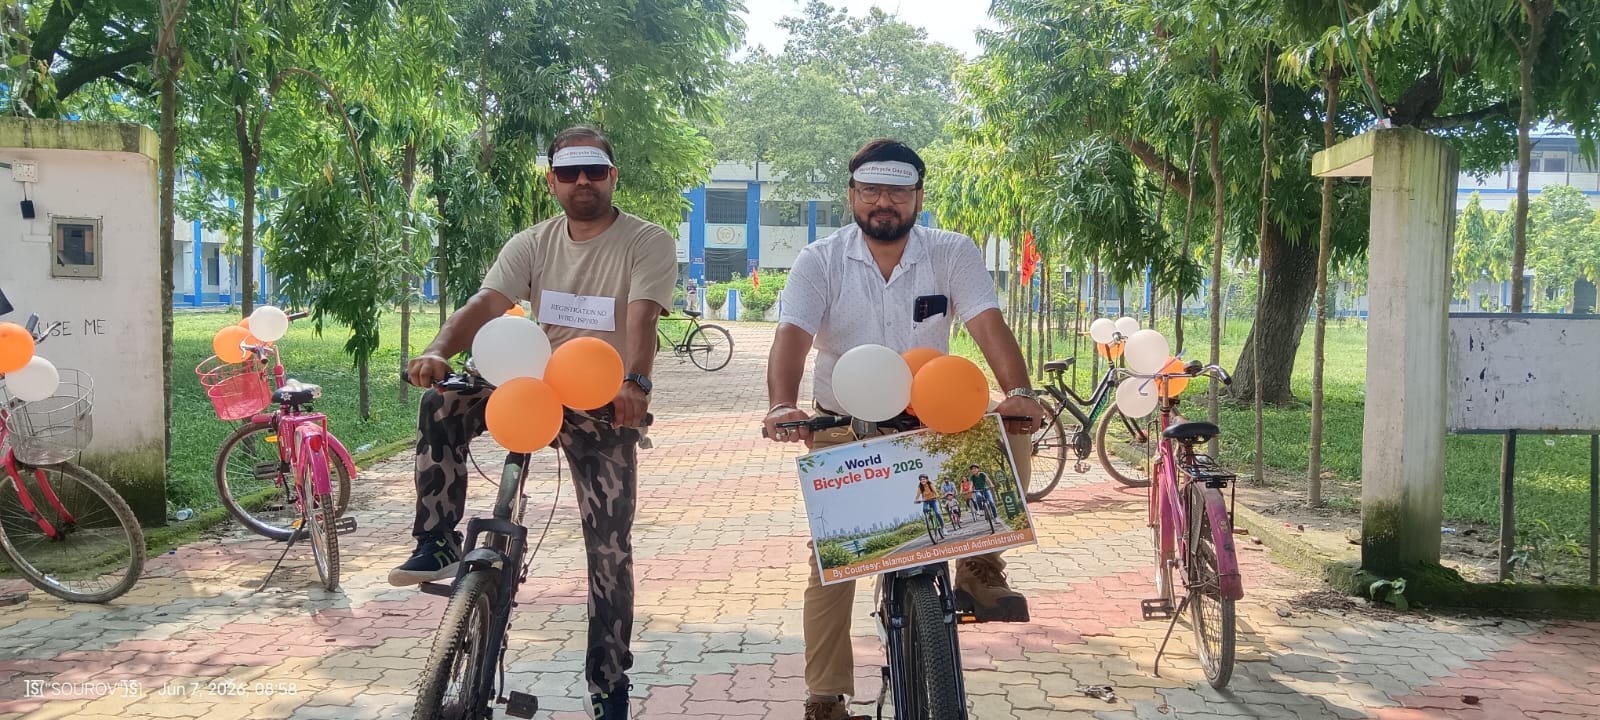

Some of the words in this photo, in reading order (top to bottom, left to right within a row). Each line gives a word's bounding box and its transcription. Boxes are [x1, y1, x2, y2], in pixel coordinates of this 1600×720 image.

[551, 303, 596, 316] REGISTRATION
[84, 319, 106, 335] ME
[845, 454, 882, 470] World
[813, 472, 862, 491] Bicycle
[863, 466, 891, 480] Day
[892, 459, 924, 474] 2026
[832, 569, 843, 577] By
[844, 561, 881, 575] Courtesy:
[882, 553, 915, 567] Islampur
[916, 542, 970, 560] Sub-Divisional
[971, 532, 1025, 550] Administrative
